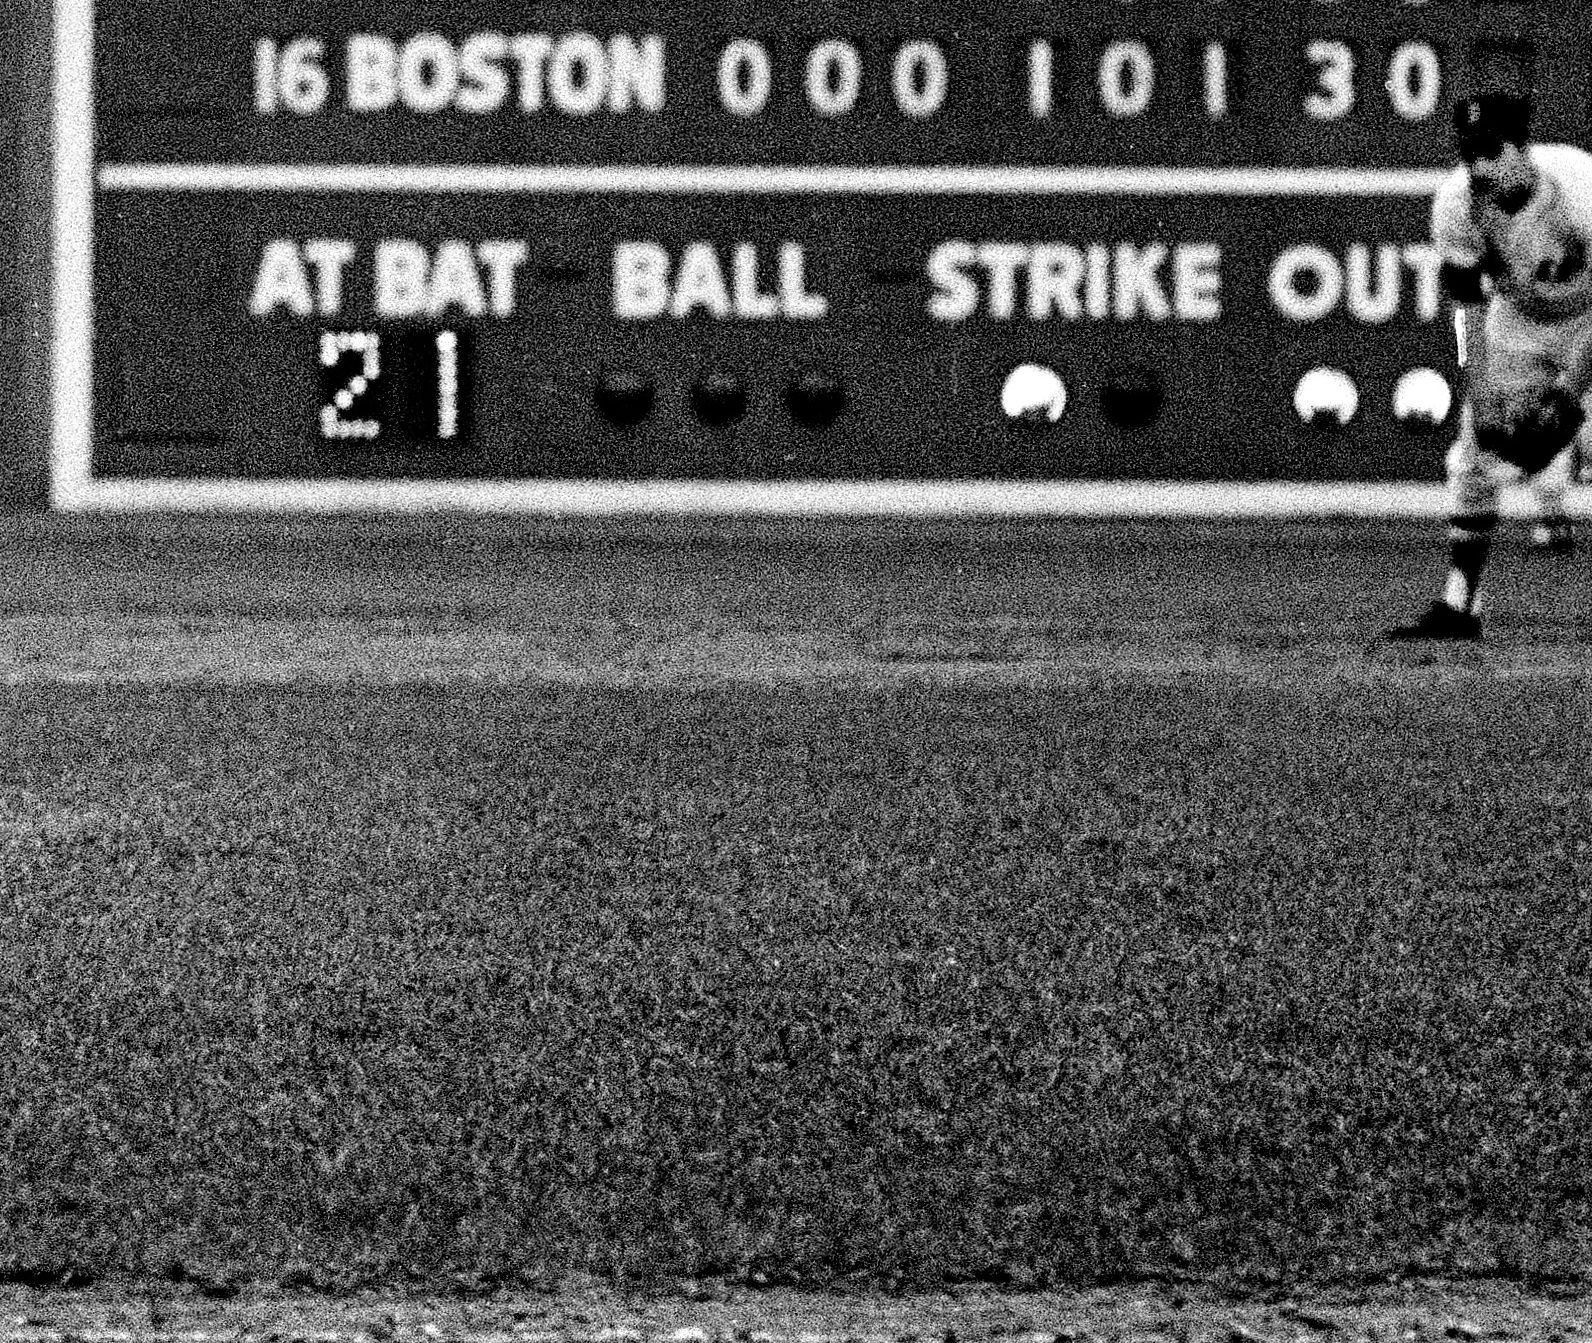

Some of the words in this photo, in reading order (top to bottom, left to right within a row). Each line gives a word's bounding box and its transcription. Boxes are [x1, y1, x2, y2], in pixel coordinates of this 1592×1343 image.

[253, 37, 330, 116] 16
[345, 30, 667, 116] BOSTON
[716, 38, 772, 116] 0
[805, 39, 862, 116] 0
[892, 41, 948, 117] 0
[1027, 38, 1054, 117] 1
[1098, 39, 1154, 117] 0
[1203, 41, 1227, 119] 1
[1305, 40, 1355, 121] 3
[1389, 42, 1442, 120] 0
[248, 237, 356, 317] AT
[373, 237, 529, 319] BAT
[611, 240, 828, 321] BALL
[926, 239, 1221, 322] STRIKE
[1268, 241, 1445, 323] OUT
[318, 329, 459, 438] 21
